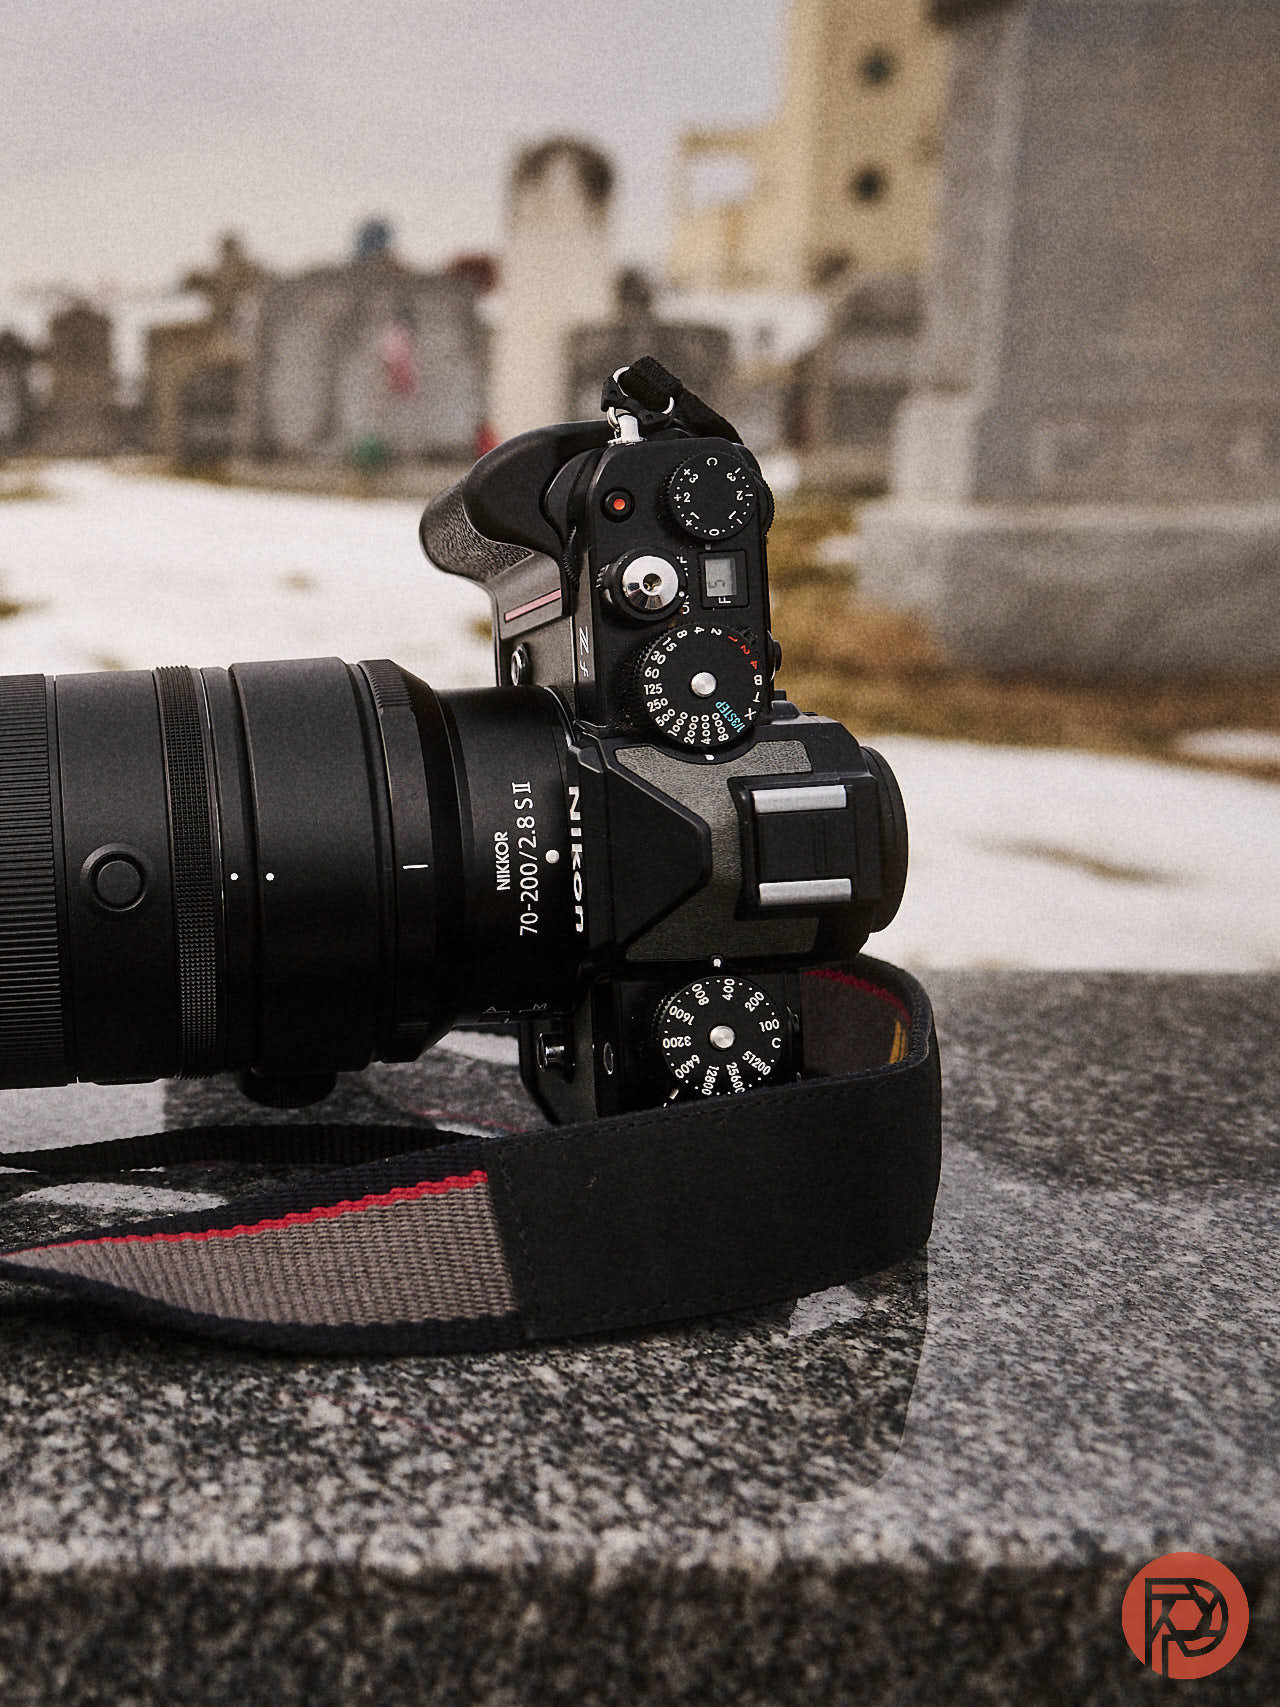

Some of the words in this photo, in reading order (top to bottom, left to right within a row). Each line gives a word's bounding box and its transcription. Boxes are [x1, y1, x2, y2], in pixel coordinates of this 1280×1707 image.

[706, 457, 718, 466] C
[676, 629, 688, 639] 8
[693, 626, 705, 635] 4
[710, 627, 723, 636] 2
[662, 636, 678, 652] 15
[739, 644, 751, 655] 2
[650, 650, 667, 665] 30
[644, 666, 660, 679] 60
[753, 674, 763, 686] B
[643, 683, 663, 695] 125
[646, 697, 669, 713] 250
[655, 708, 676, 727] 500
[667, 711, 689, 737] 1000
[683, 715, 700, 745] 2000
[700, 714, 712, 745] 4000
[711, 712, 730, 742] 8000
[514, 797, 534, 810] S
[494, 831, 511, 891] NIKKOR
[568, 786, 584, 933] Nikon
[516, 815, 539, 936] 70-200/2.8
[691, 983, 710, 1006] 800
[721, 978, 736, 1001] 400
[744, 991, 765, 1012] 200
[668, 1005, 695, 1026] 1600
[758, 1018, 780, 1033] 100
[662, 1035, 692, 1049] 3200
[771, 1037, 782, 1049] C
[674, 1054, 701, 1079] 6400
[741, 1050, 771, 1076] 51200
[701, 1065, 720, 1096] 12800
